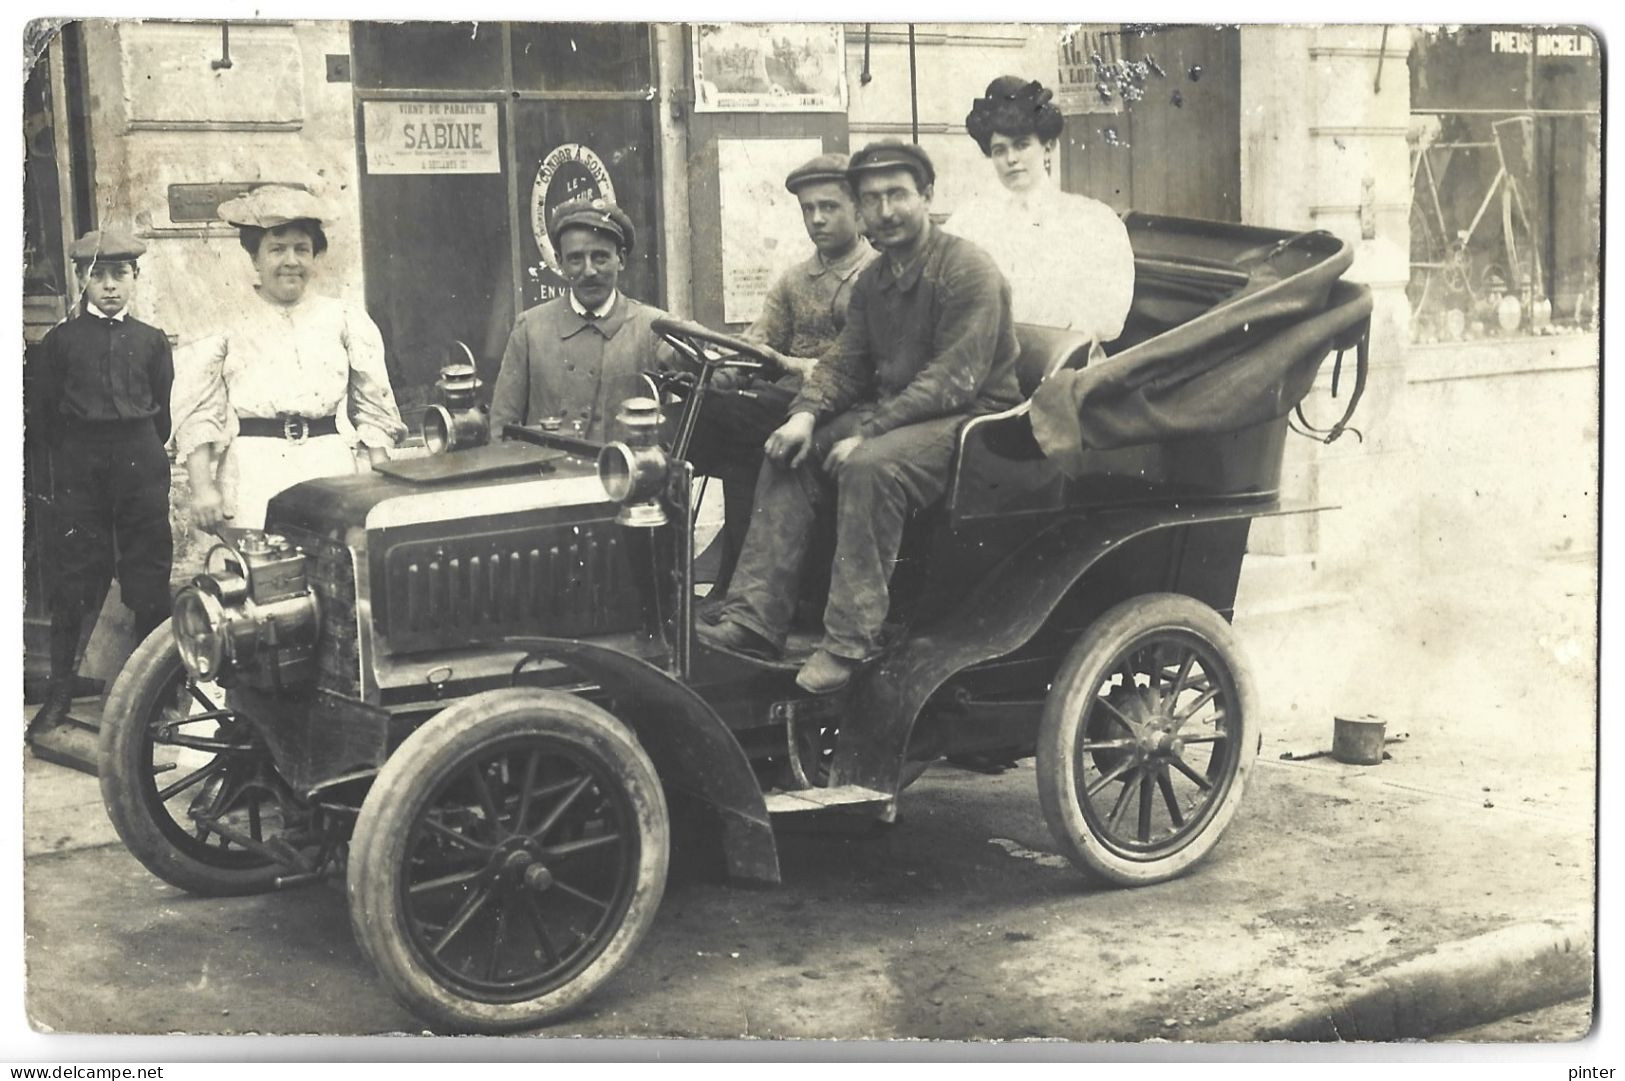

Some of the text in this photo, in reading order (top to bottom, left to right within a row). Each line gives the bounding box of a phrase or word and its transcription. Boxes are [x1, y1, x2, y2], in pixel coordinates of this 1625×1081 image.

[1491, 31, 1593, 56] PNEUS MICHELIN
[399, 104, 424, 114] VIENT
[429, 104, 440, 114] DE
[403, 123, 483, 149] SABINE
